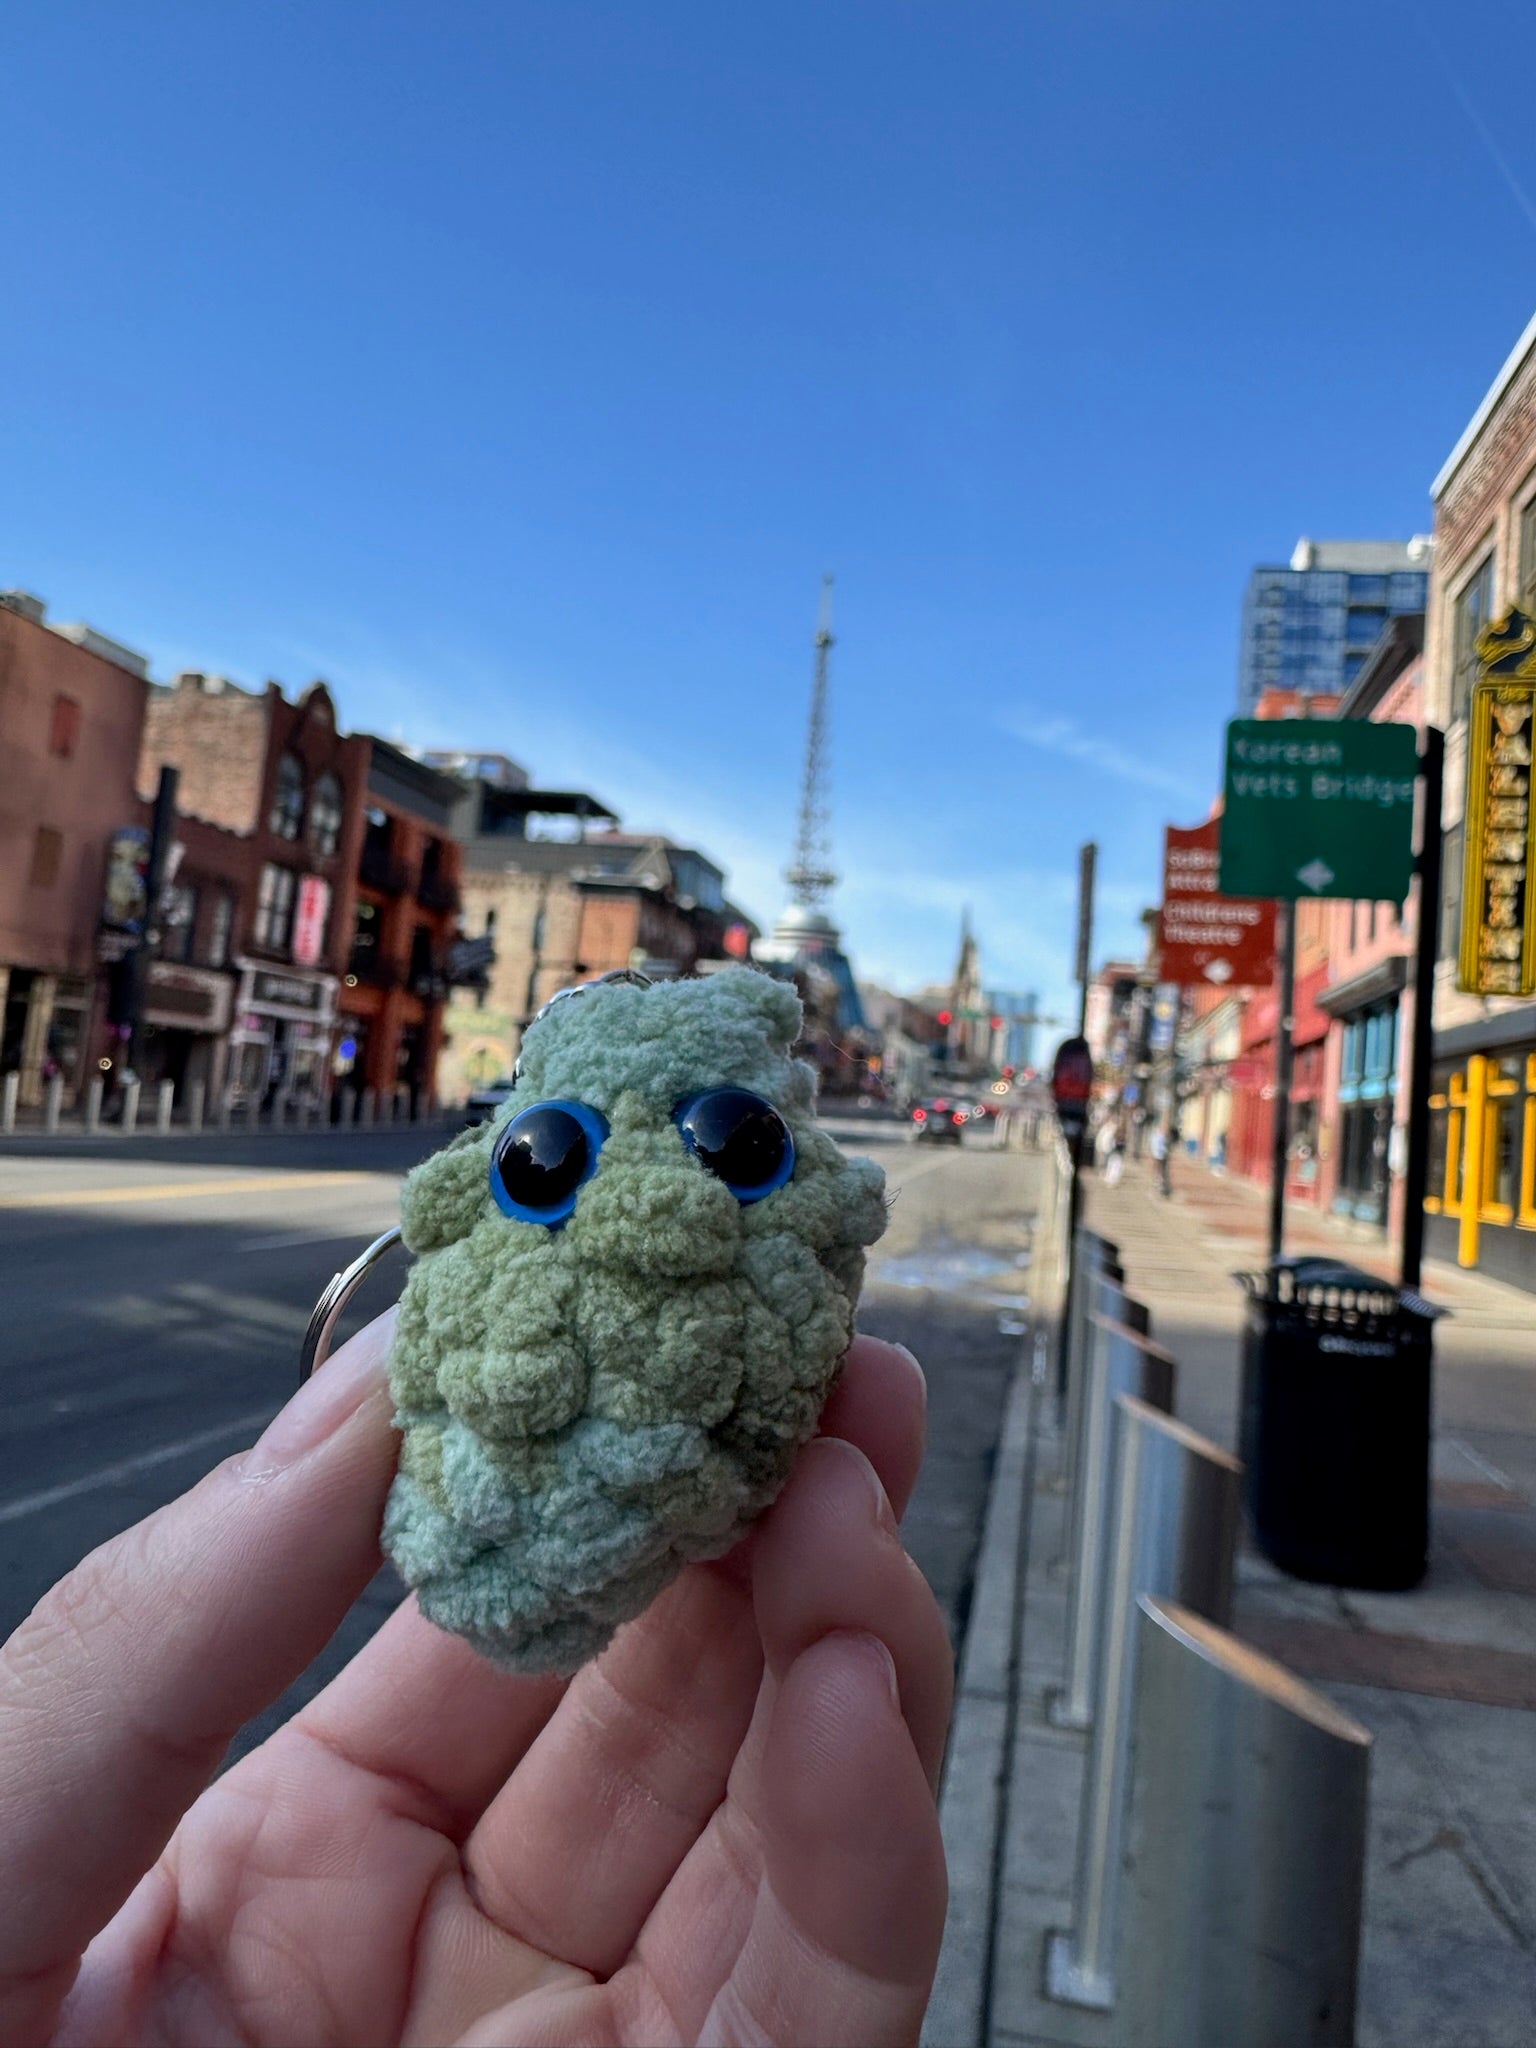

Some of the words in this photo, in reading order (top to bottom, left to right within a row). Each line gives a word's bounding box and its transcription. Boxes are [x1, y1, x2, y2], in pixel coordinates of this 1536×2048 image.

[1233, 737, 1342, 764] Korean
[1233, 771, 1297, 797] Vets
[1311, 771, 1413, 807] Bridge
